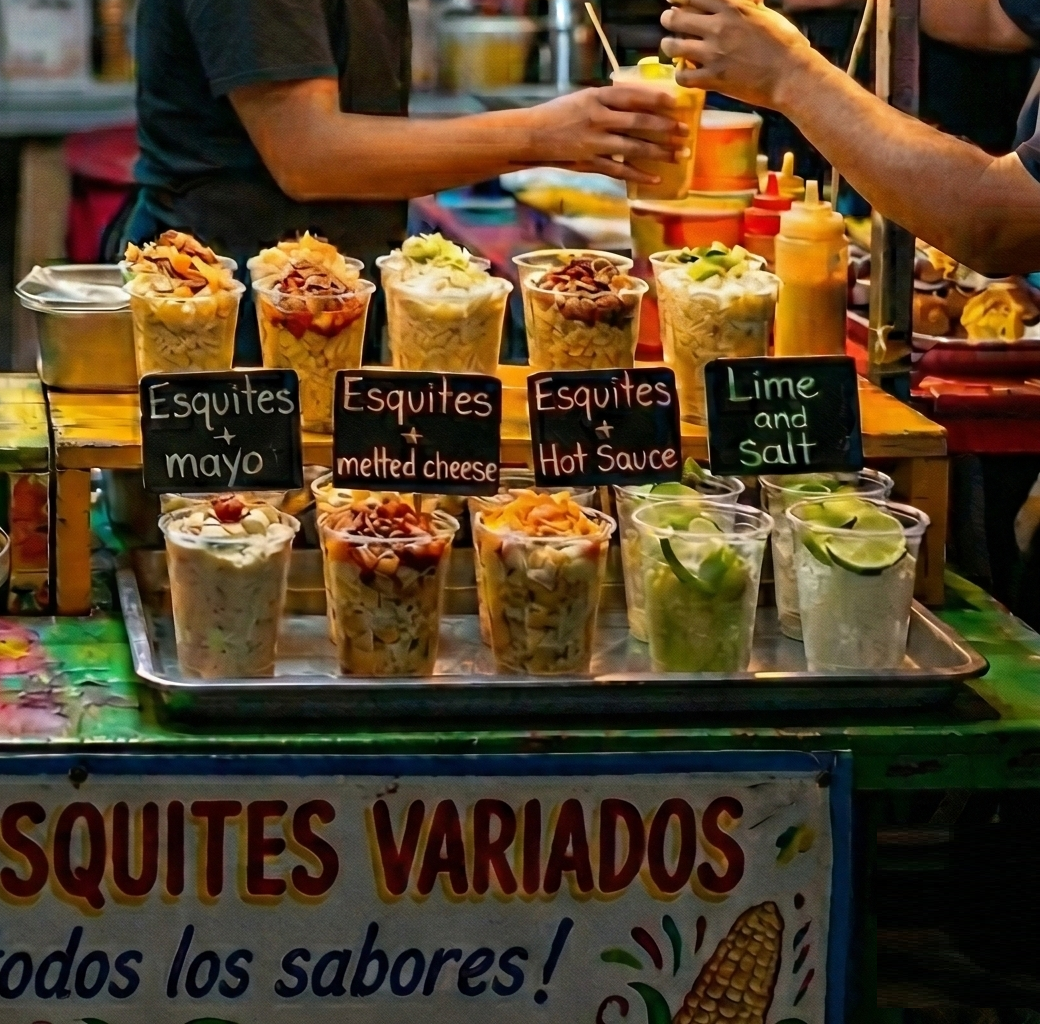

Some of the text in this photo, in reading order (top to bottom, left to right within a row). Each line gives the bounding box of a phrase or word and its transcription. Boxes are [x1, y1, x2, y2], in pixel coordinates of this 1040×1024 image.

[149, 375, 295, 431] Esquites
[343, 376, 493, 426] Esquites
[534, 371, 672, 420] Esquites
[727, 366, 820, 402] Lime
[213, 427, 237, 446] +
[400, 427, 424, 445] +
[753, 406, 808, 430] and
[165, 447, 264, 488] mayo
[336, 447, 498, 483] melted cheese
[539, 443, 679, 476] Hot Sauce
[371, 795, 746, 898] VARIADOS
[165, 923, 254, 1000] los
[273, 917, 575, 1005] sabores!
